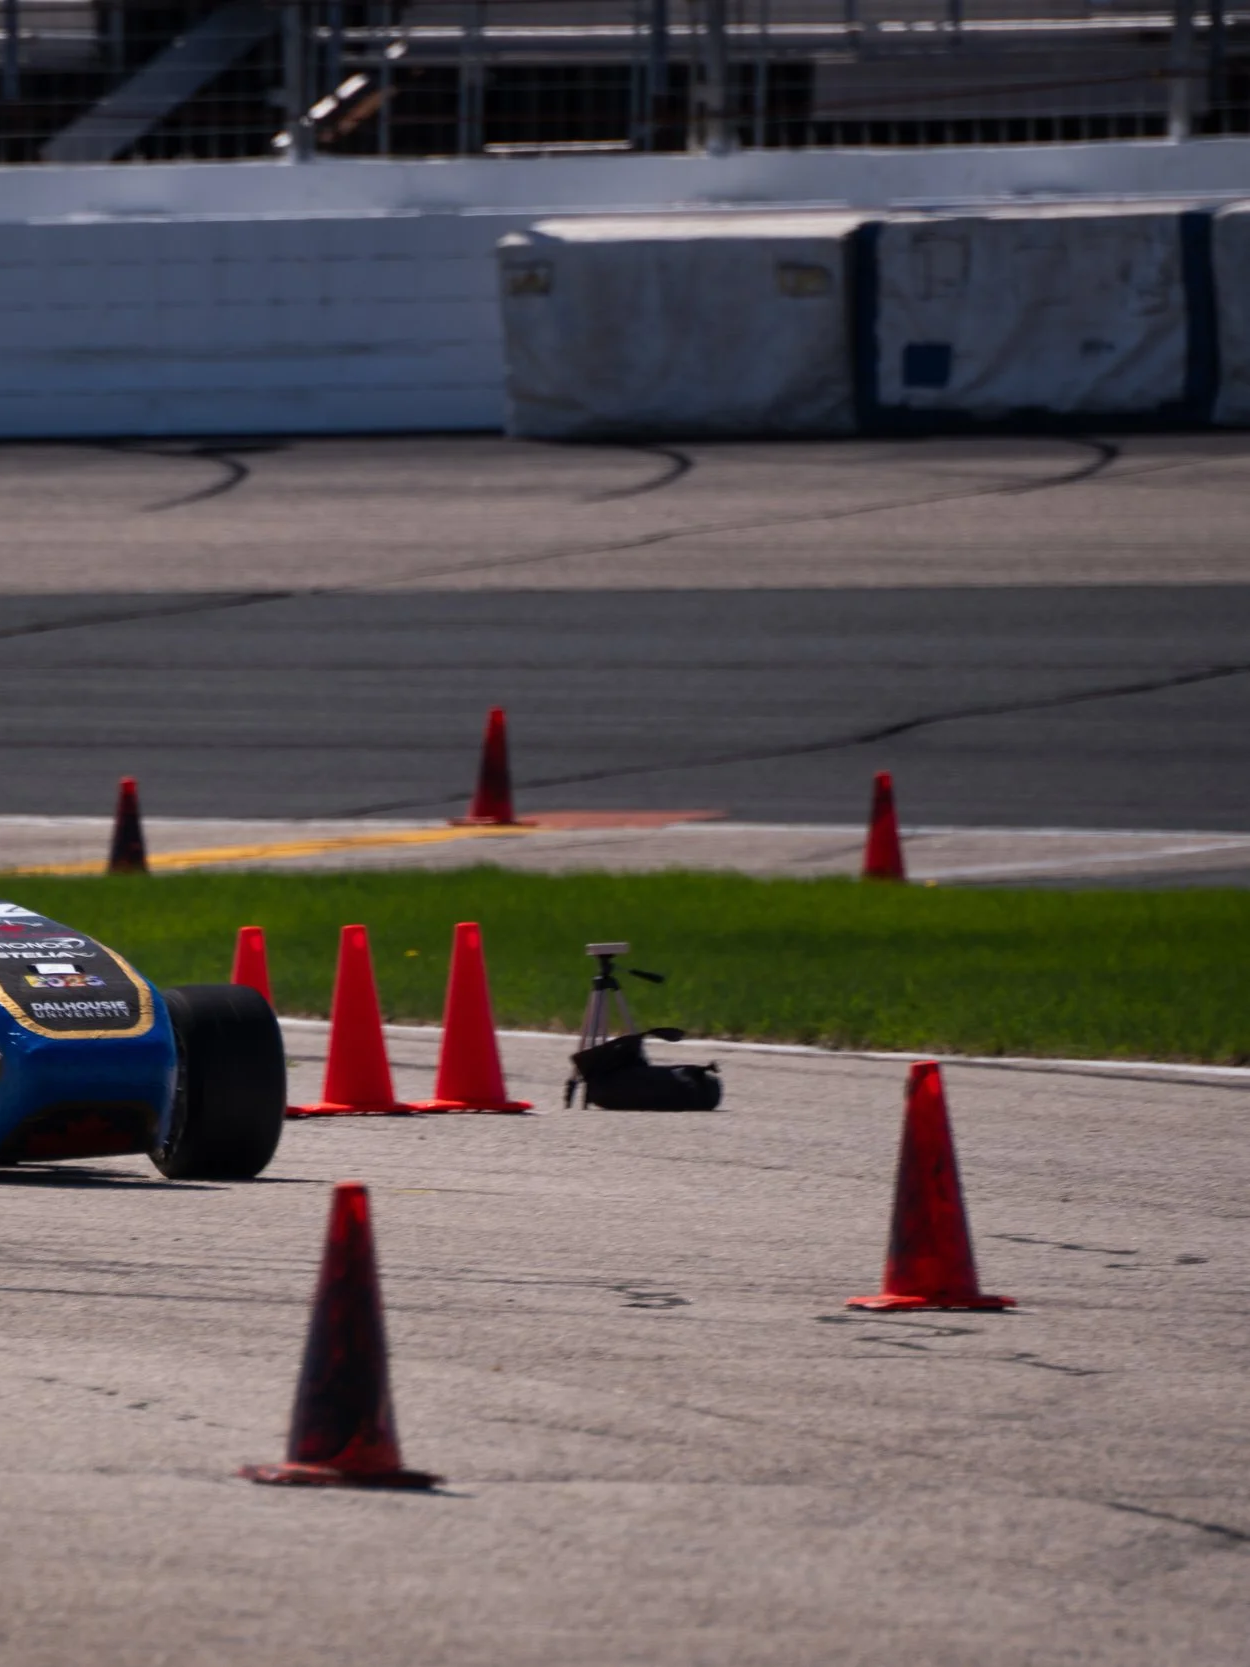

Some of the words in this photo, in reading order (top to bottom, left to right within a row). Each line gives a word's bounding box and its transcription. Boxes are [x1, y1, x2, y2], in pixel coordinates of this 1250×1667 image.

[23, 975, 107, 989] 2025
[30, 1001, 128, 1011] DALHOUSIE
[34, 1010, 131, 1019] UNIVERSITY
